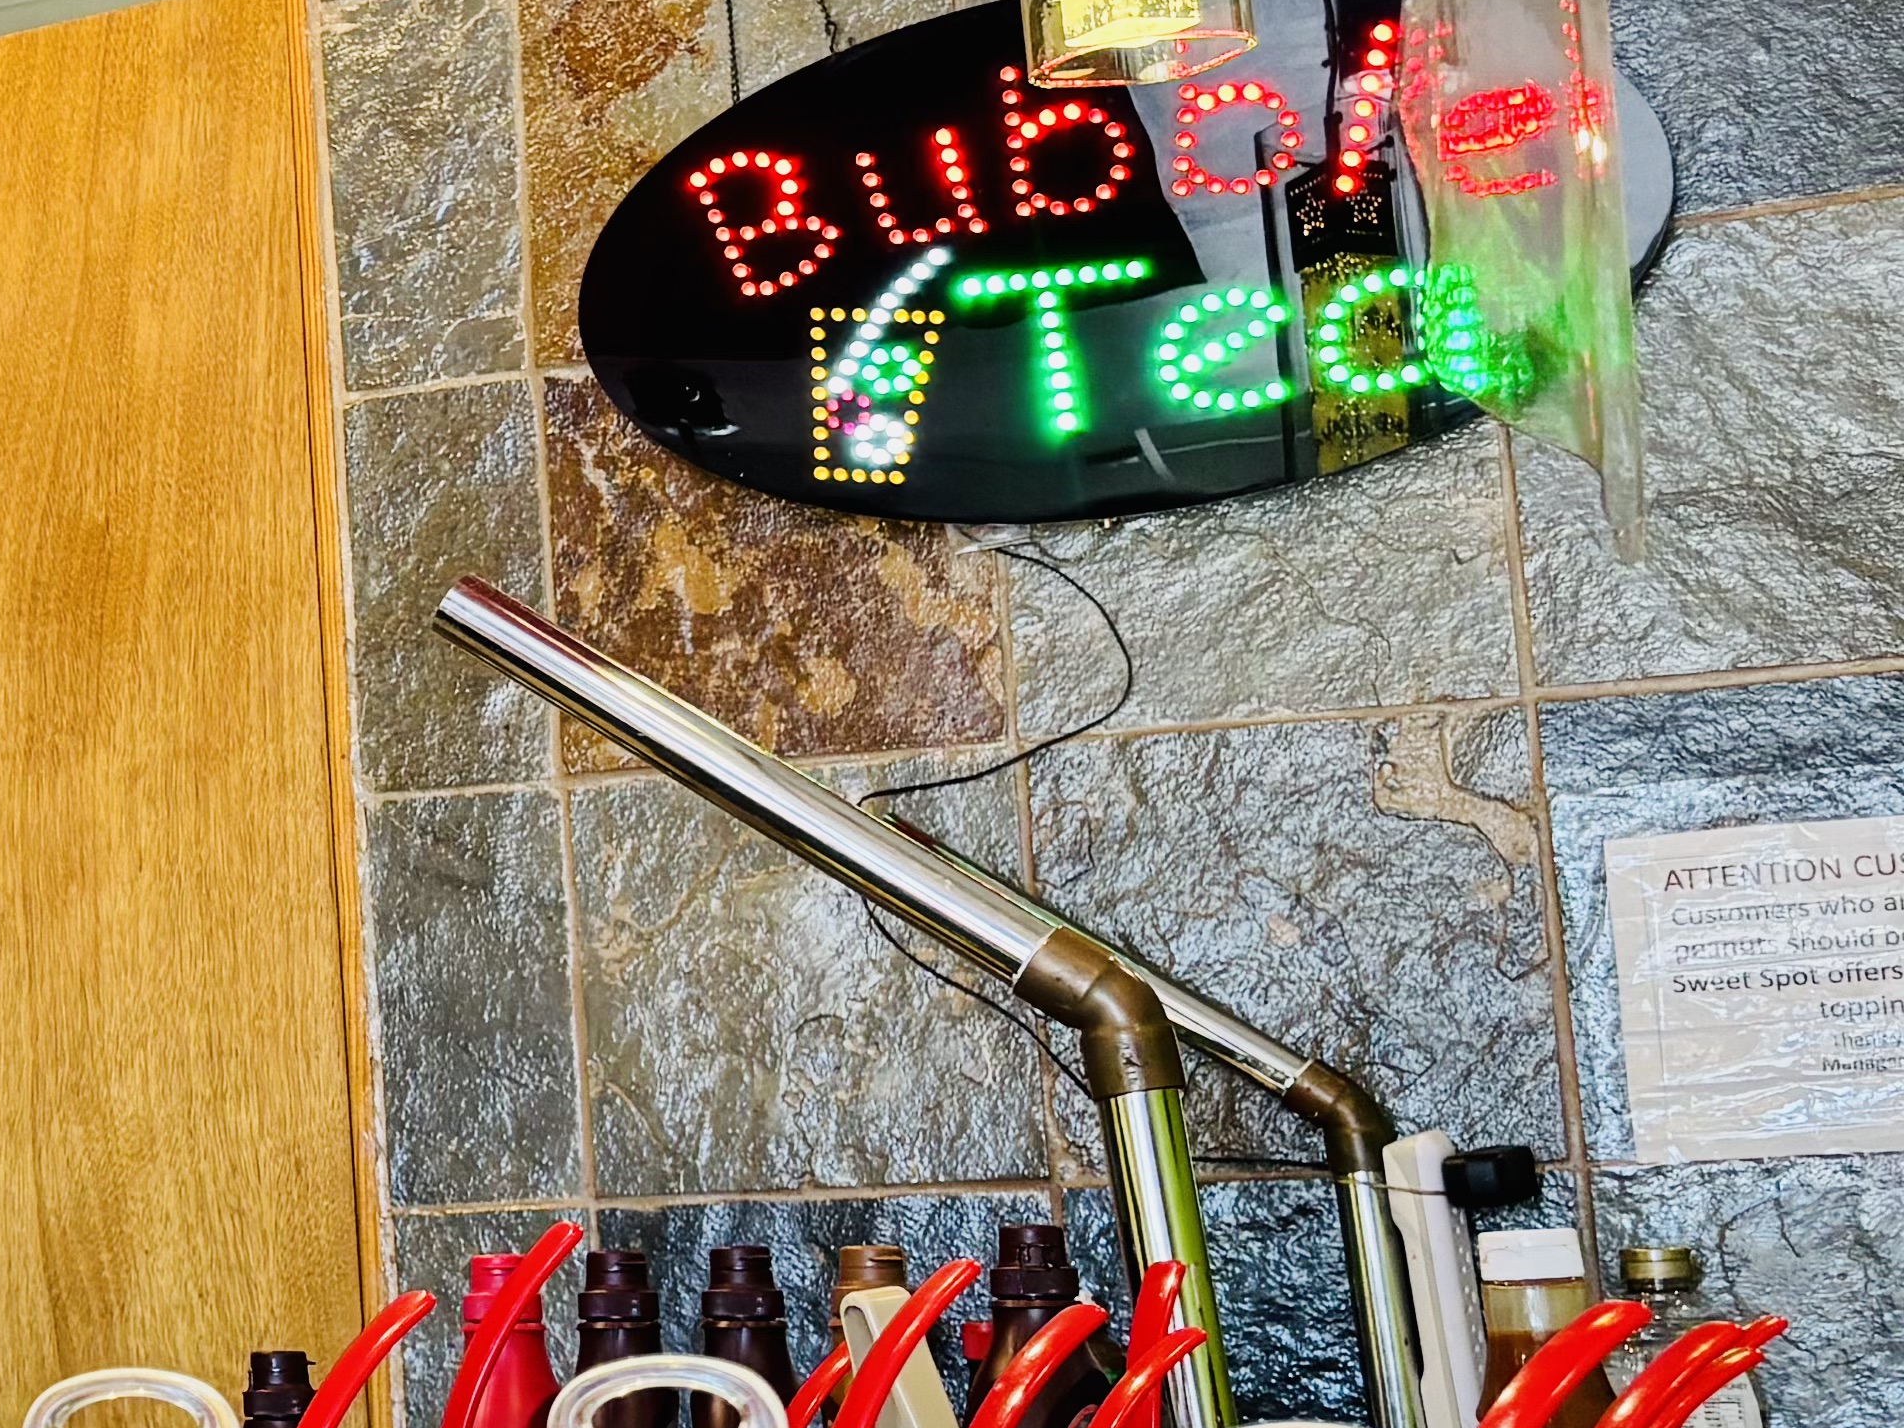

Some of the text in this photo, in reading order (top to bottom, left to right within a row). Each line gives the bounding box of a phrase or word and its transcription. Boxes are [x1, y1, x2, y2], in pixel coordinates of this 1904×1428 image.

[951, 258, 1482, 442] Tea
[1664, 858, 1841, 891] ATTENTION
[1672, 903, 1810, 926] Customers
[1819, 895, 1874, 915] who
[1788, 929, 1874, 952] should
[1673, 961, 1903, 993] Sweet Spot offers
